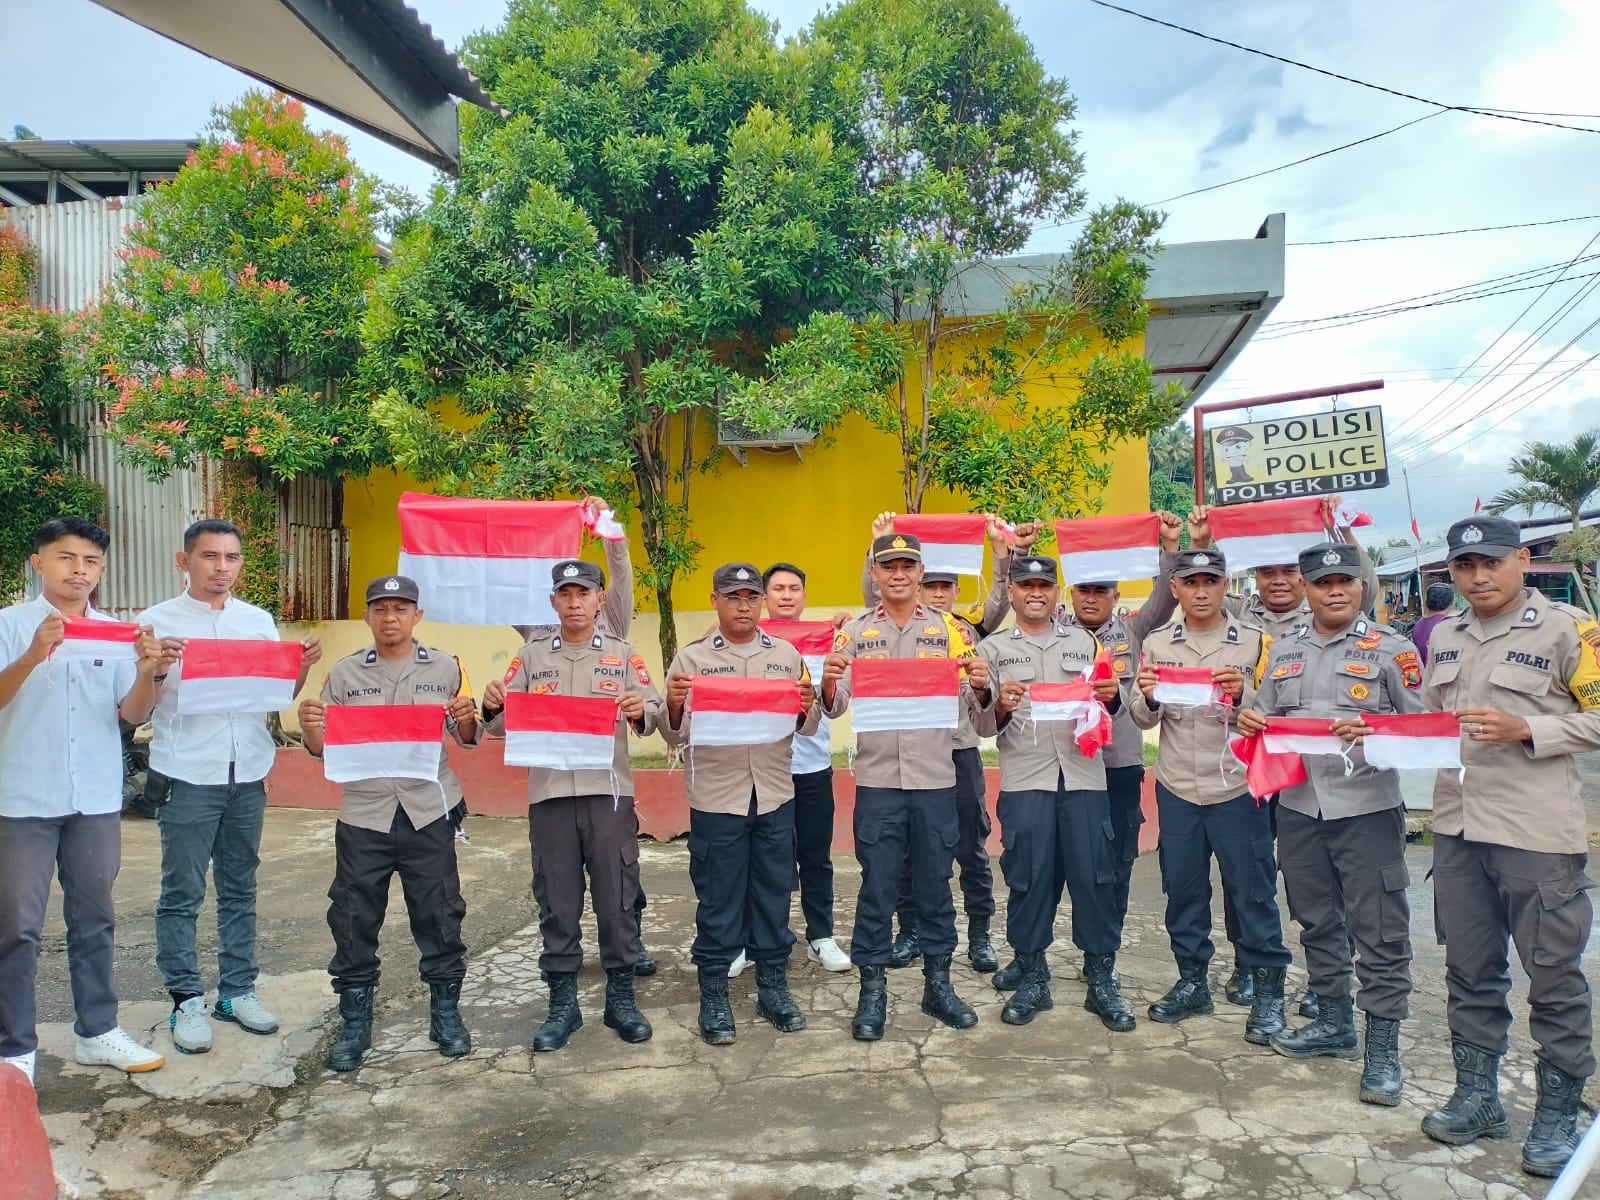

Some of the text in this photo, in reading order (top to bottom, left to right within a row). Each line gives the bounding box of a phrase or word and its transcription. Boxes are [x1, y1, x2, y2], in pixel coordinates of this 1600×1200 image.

[1264, 411, 1372, 445] POLISI
[1266, 445, 1377, 476] POLICE
[1223, 471, 1377, 502] POLSEK IBU
[916, 637, 947, 648] POLRI
[1062, 651, 1090, 662] POLRI
[1344, 650, 1380, 662] POLRI
[1505, 650, 1551, 670] POLRI
[594, 667, 624, 678] POLRI
[701, 663, 792, 676] CHAIRUL POLRI
[346, 686, 382, 699] MILTON
